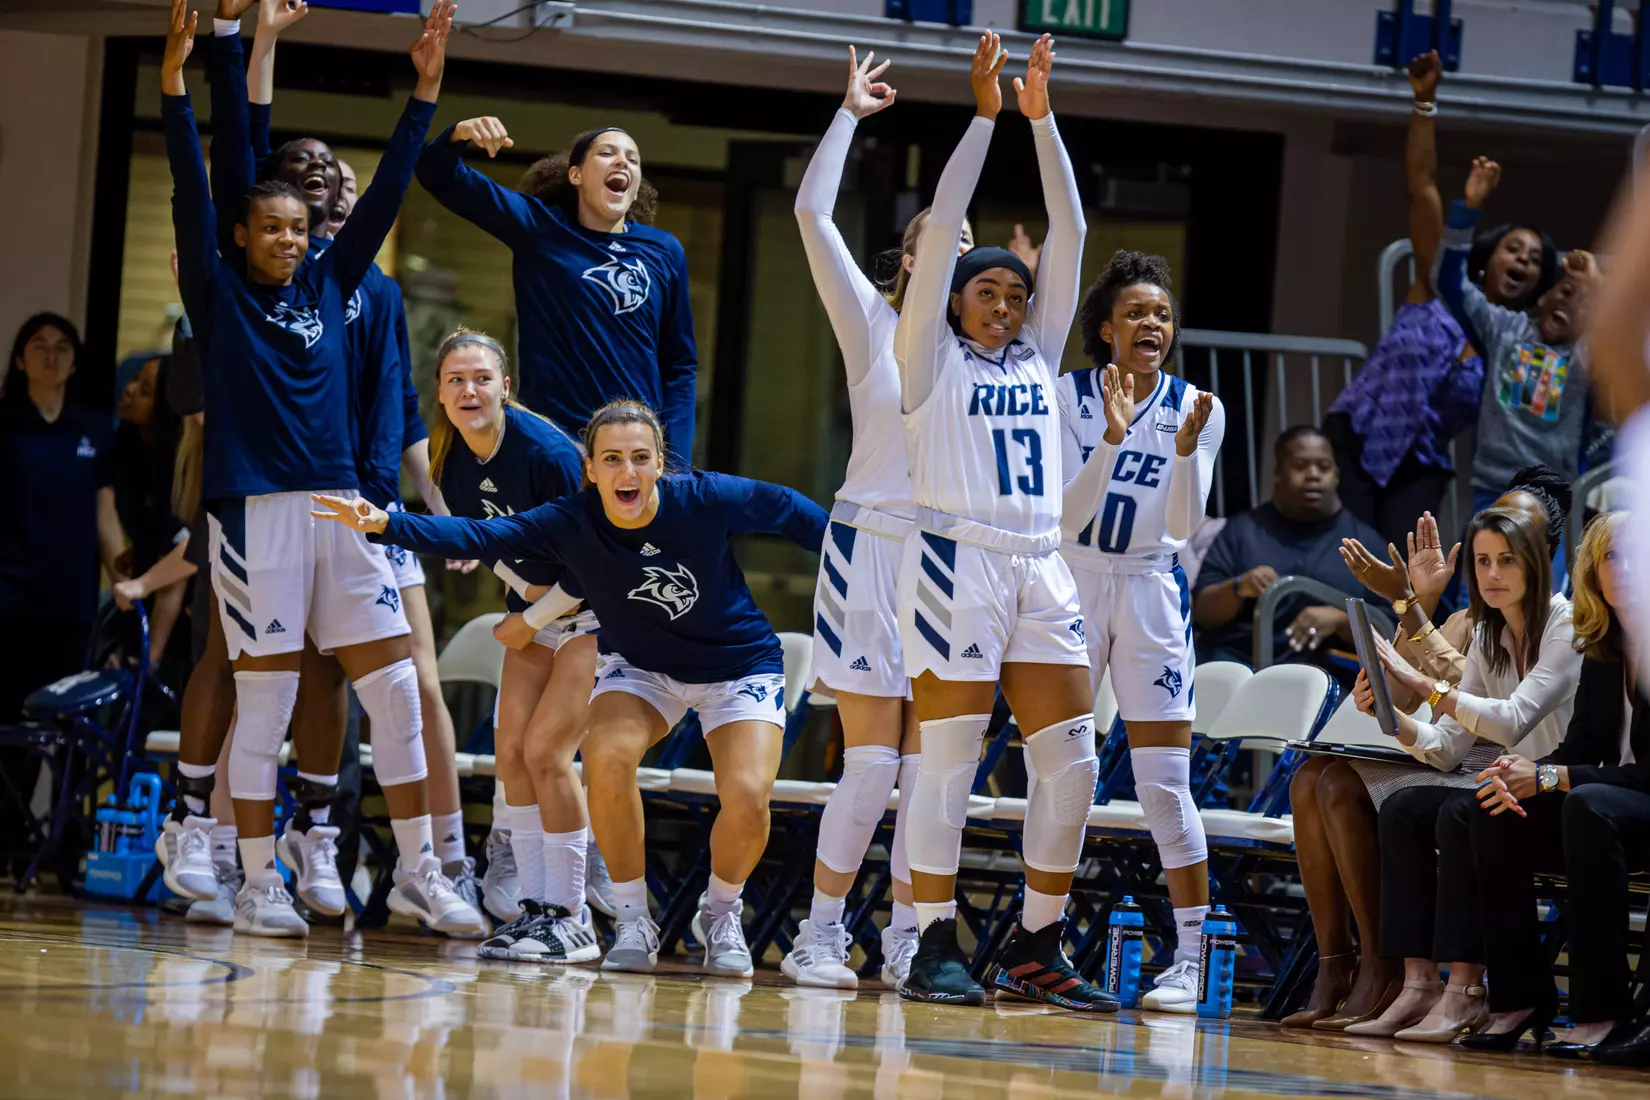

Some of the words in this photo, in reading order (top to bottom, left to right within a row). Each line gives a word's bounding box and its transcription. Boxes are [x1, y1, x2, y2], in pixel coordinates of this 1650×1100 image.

[968, 383, 1049, 416] RICE
[992, 429, 1044, 496] 13
[849, 664, 871, 672] adidas
[1109, 926, 1120, 993] POWERADE
[1199, 934, 1208, 1001] POWERADE
